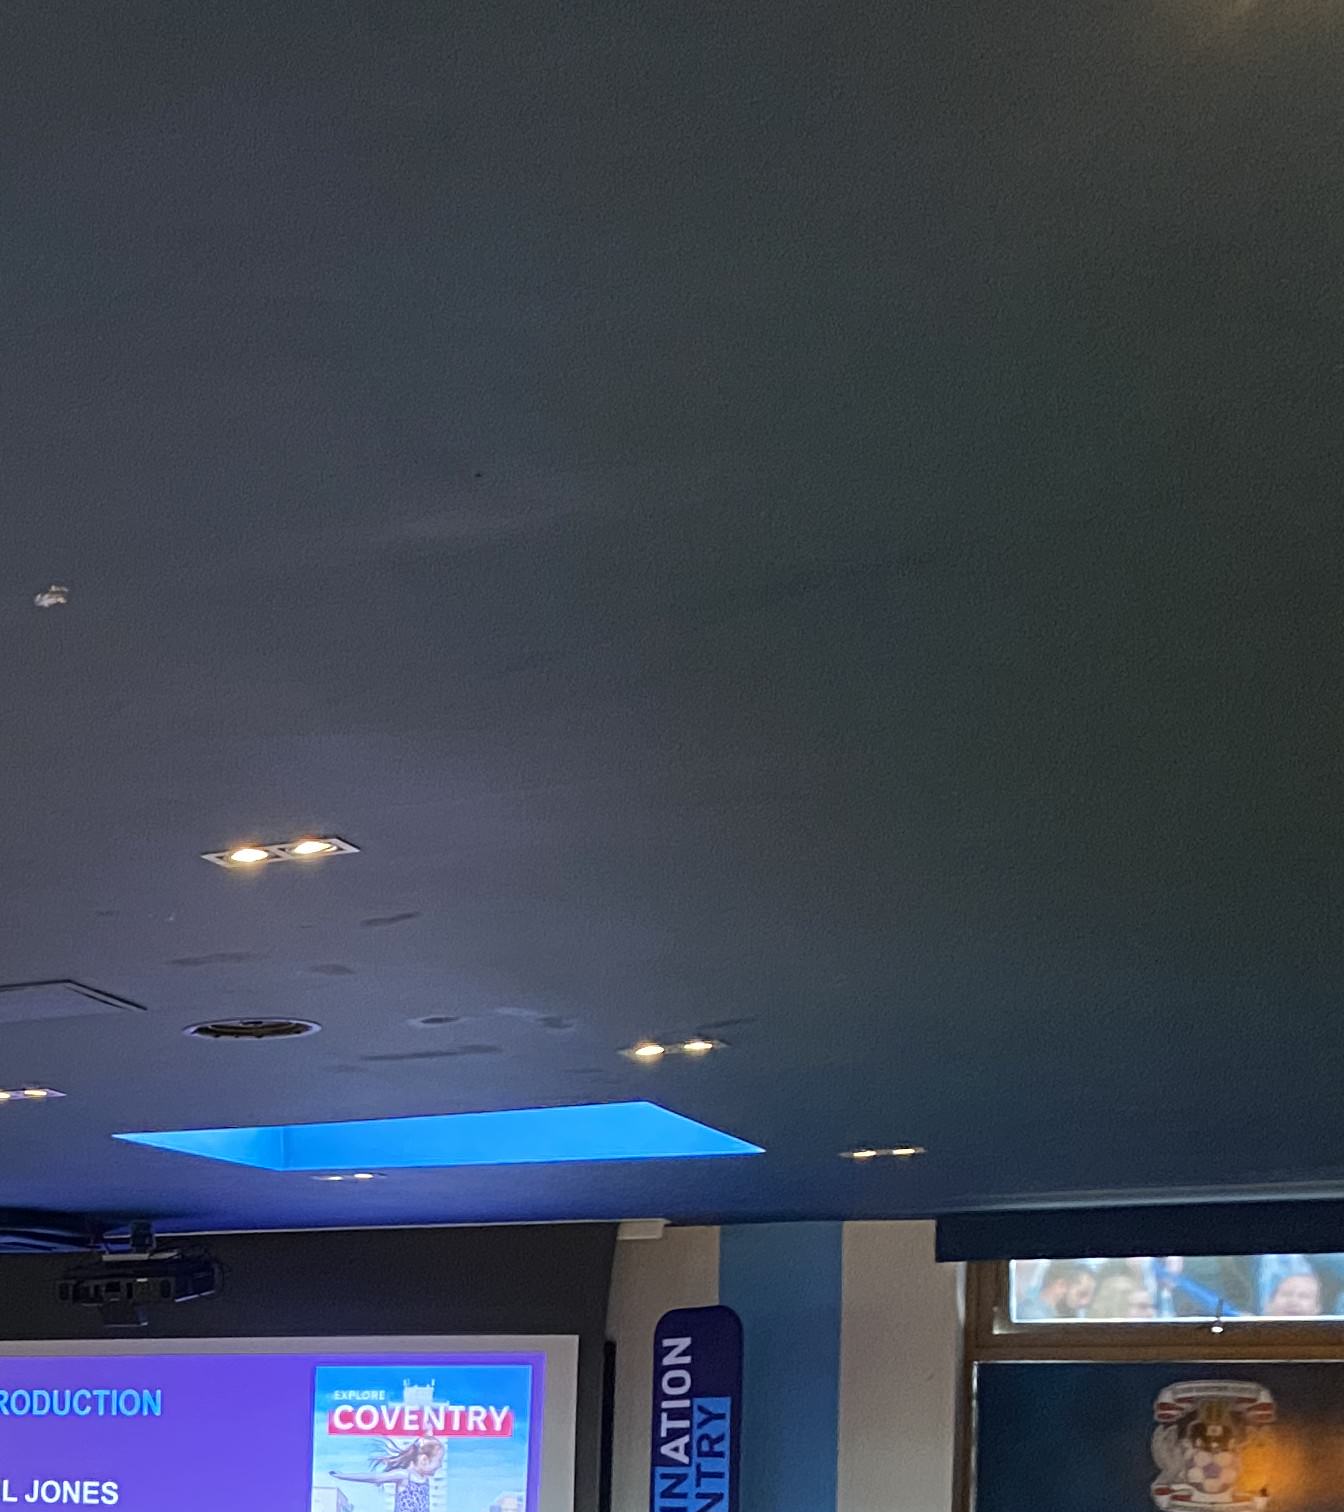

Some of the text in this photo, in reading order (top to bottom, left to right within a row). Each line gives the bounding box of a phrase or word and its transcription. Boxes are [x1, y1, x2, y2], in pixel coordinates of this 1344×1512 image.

[334, 1390, 385, 1400] EXPLORE
[333, 1404, 509, 1432] COVENTRY
[24, 1480, 119, 1505] JONES
